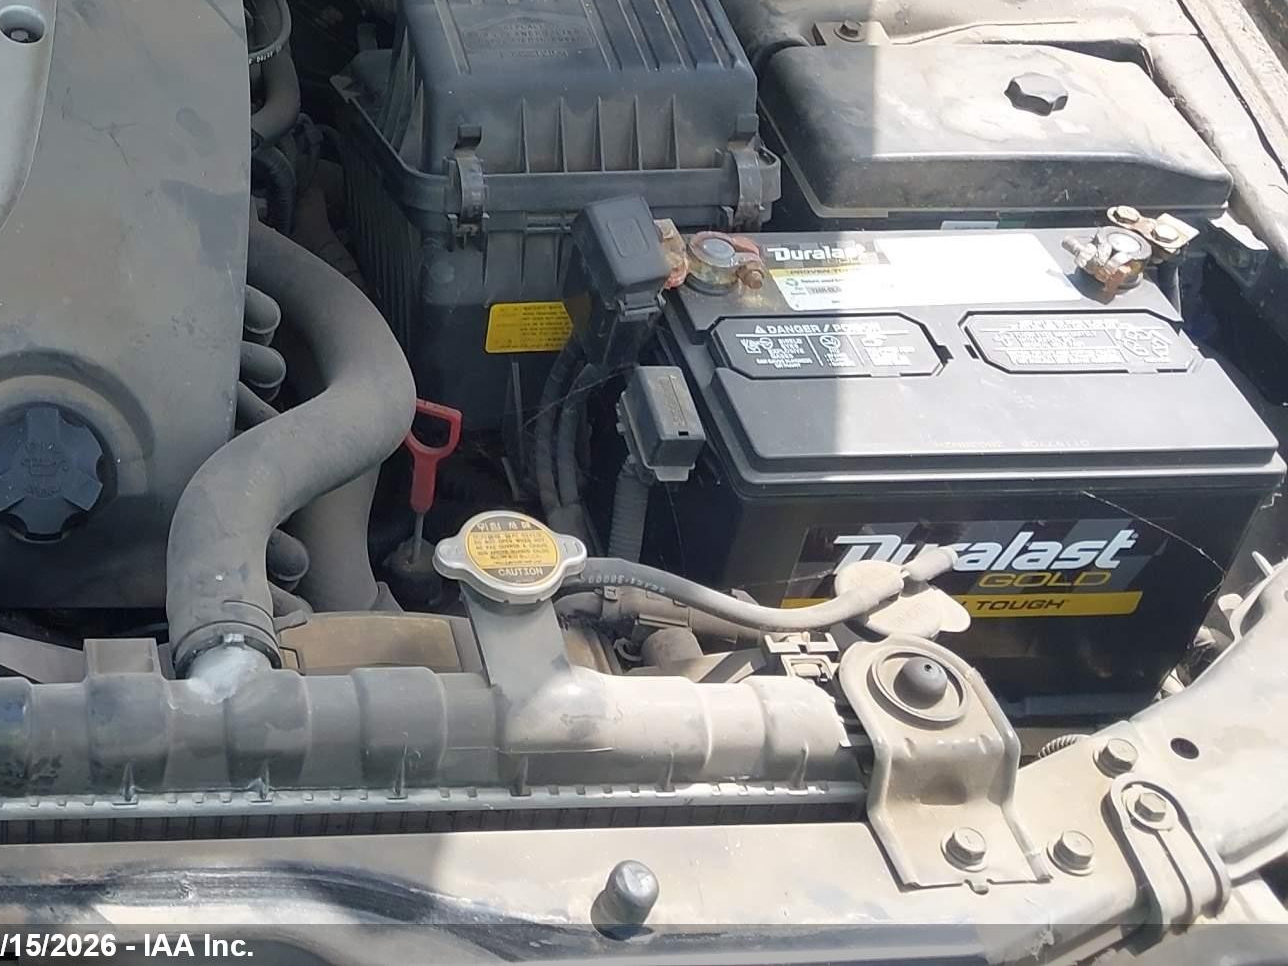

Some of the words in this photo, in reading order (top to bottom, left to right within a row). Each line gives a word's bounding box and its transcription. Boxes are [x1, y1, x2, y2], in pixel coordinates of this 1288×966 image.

[765, 324, 820, 335] DANGER
[497, 567, 544, 578] CAUTION
[978, 571, 1112, 588] GOLD
[975, 598, 1064, 611] TOUGH
